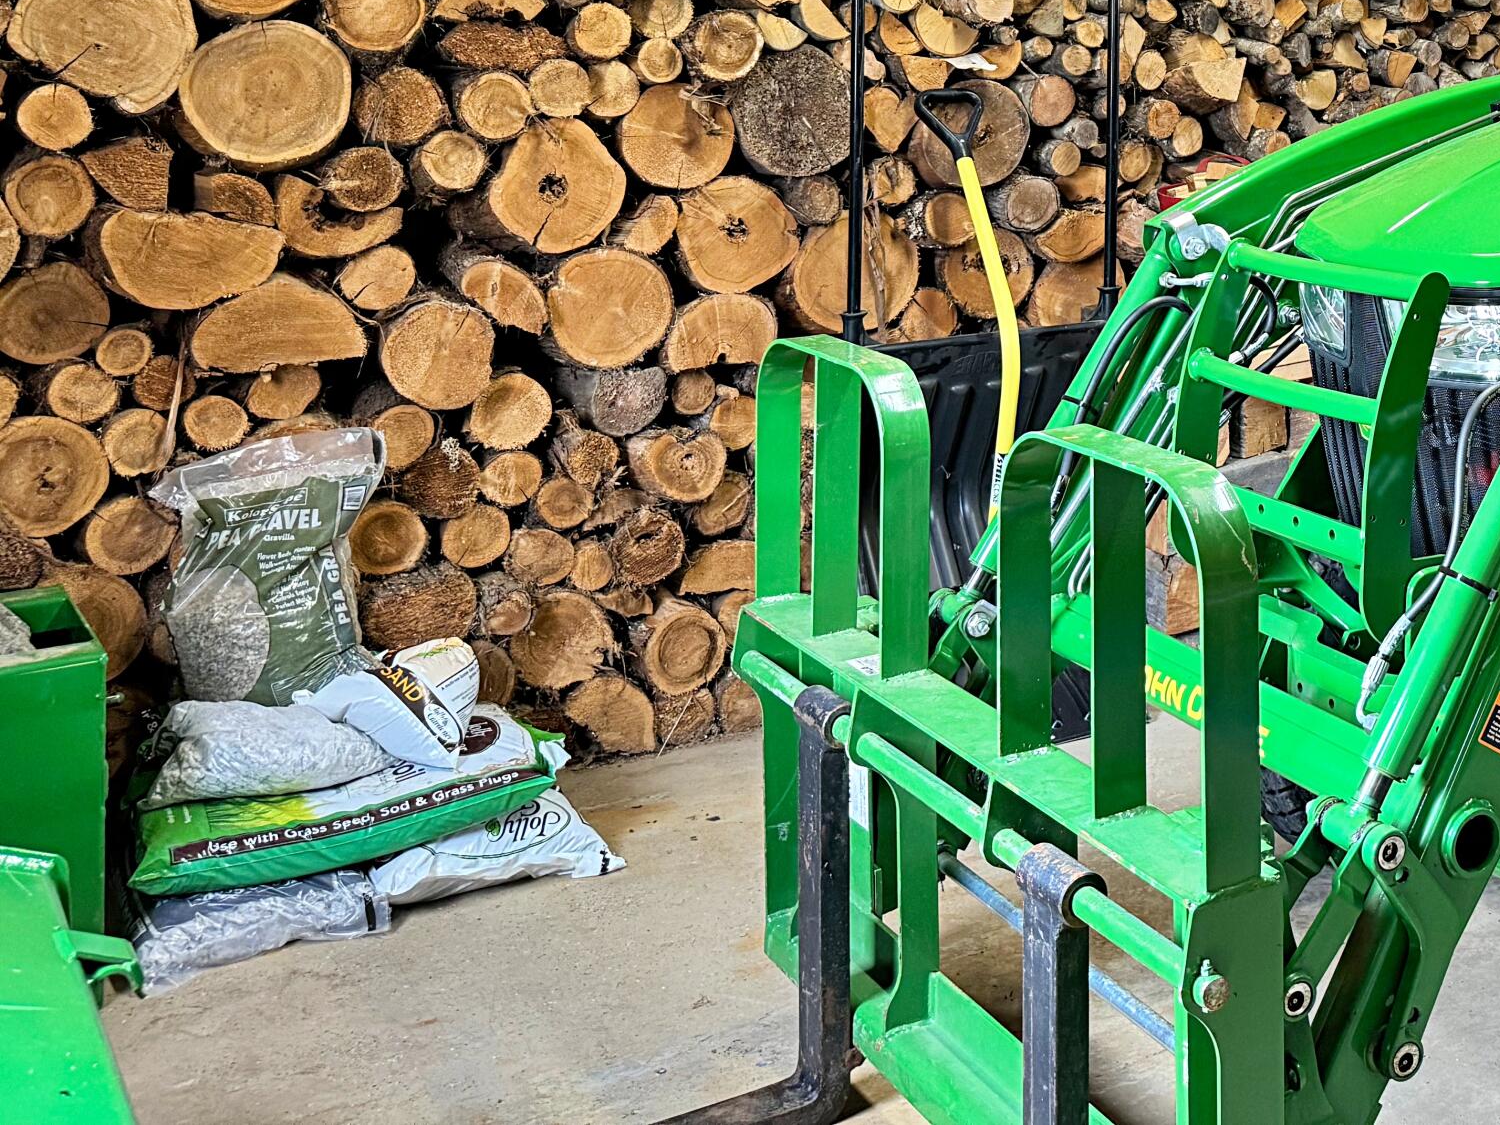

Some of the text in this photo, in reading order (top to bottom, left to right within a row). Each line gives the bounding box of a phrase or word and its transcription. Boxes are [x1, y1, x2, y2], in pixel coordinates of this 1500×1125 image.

[205, 528, 241, 551] PEA
[332, 589, 350, 626] PEA
[380, 666, 424, 703] SAND
[243, 831, 279, 847] with
[284, 824, 328, 841] Grass
[333, 813, 375, 831] Seed,
[380, 802, 410, 817] Sod
[415, 797, 428, 810] &
[432, 783, 475, 805] Grass
[479, 770, 520, 789] Plugs
[493, 809, 561, 842] Jolly
